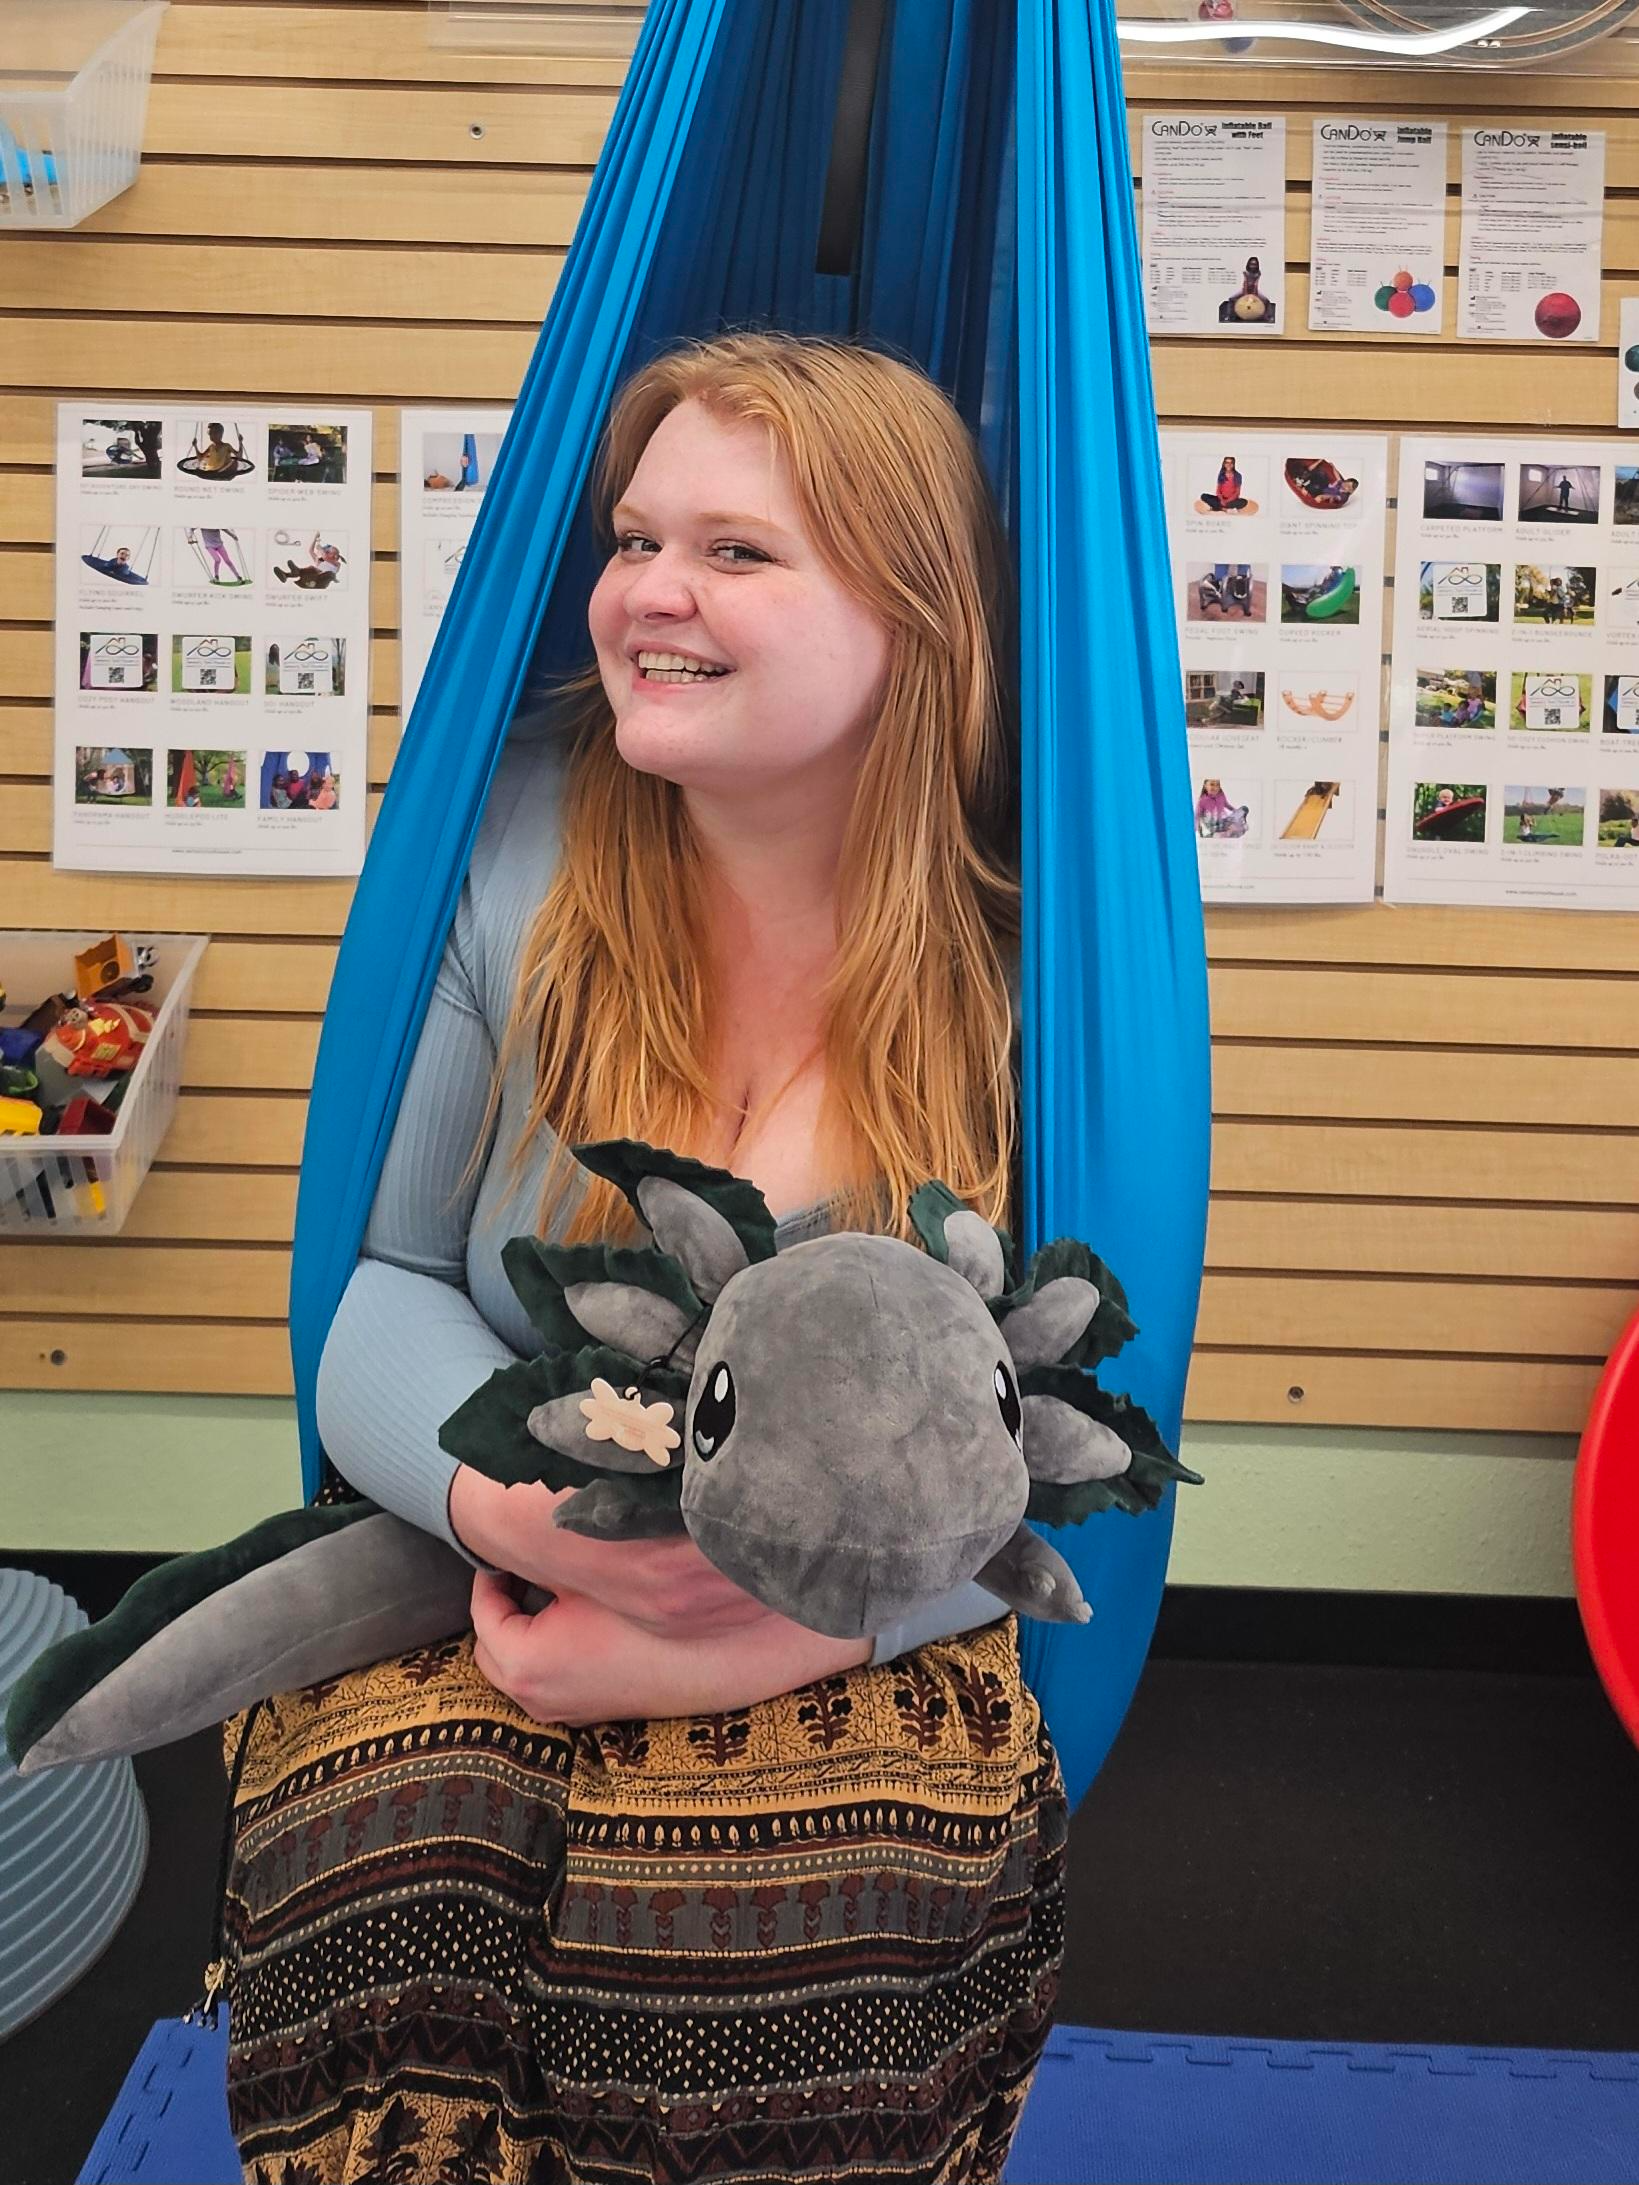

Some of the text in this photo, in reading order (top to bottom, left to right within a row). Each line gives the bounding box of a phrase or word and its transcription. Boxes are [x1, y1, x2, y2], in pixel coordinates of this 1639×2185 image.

[1221, 122, 1272, 130] Inflatable Ball
[1248, 131, 1264, 139] Feet
